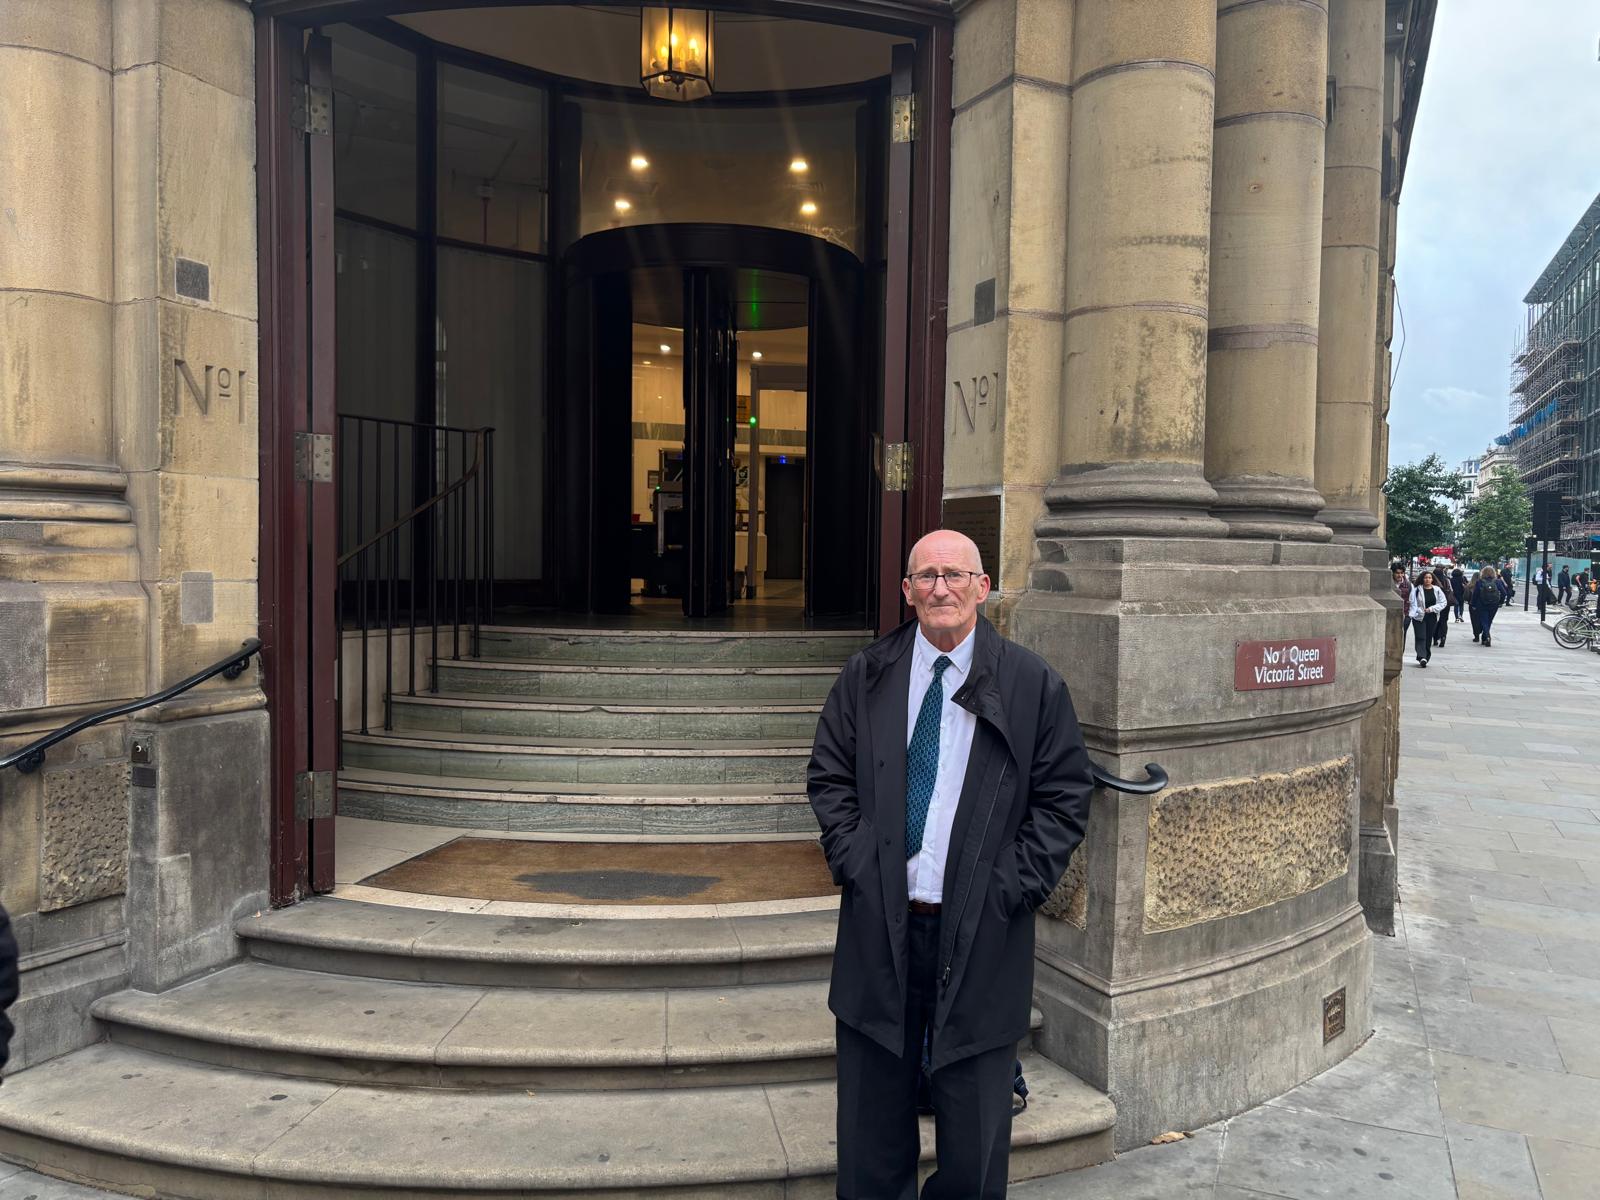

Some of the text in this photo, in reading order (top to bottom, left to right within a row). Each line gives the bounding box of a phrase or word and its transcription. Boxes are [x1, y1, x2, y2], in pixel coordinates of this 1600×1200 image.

[1263, 647, 1279, 664] No
[1289, 645, 1320, 666] Queen
[1254, 664, 1324, 684] Victoria Street
